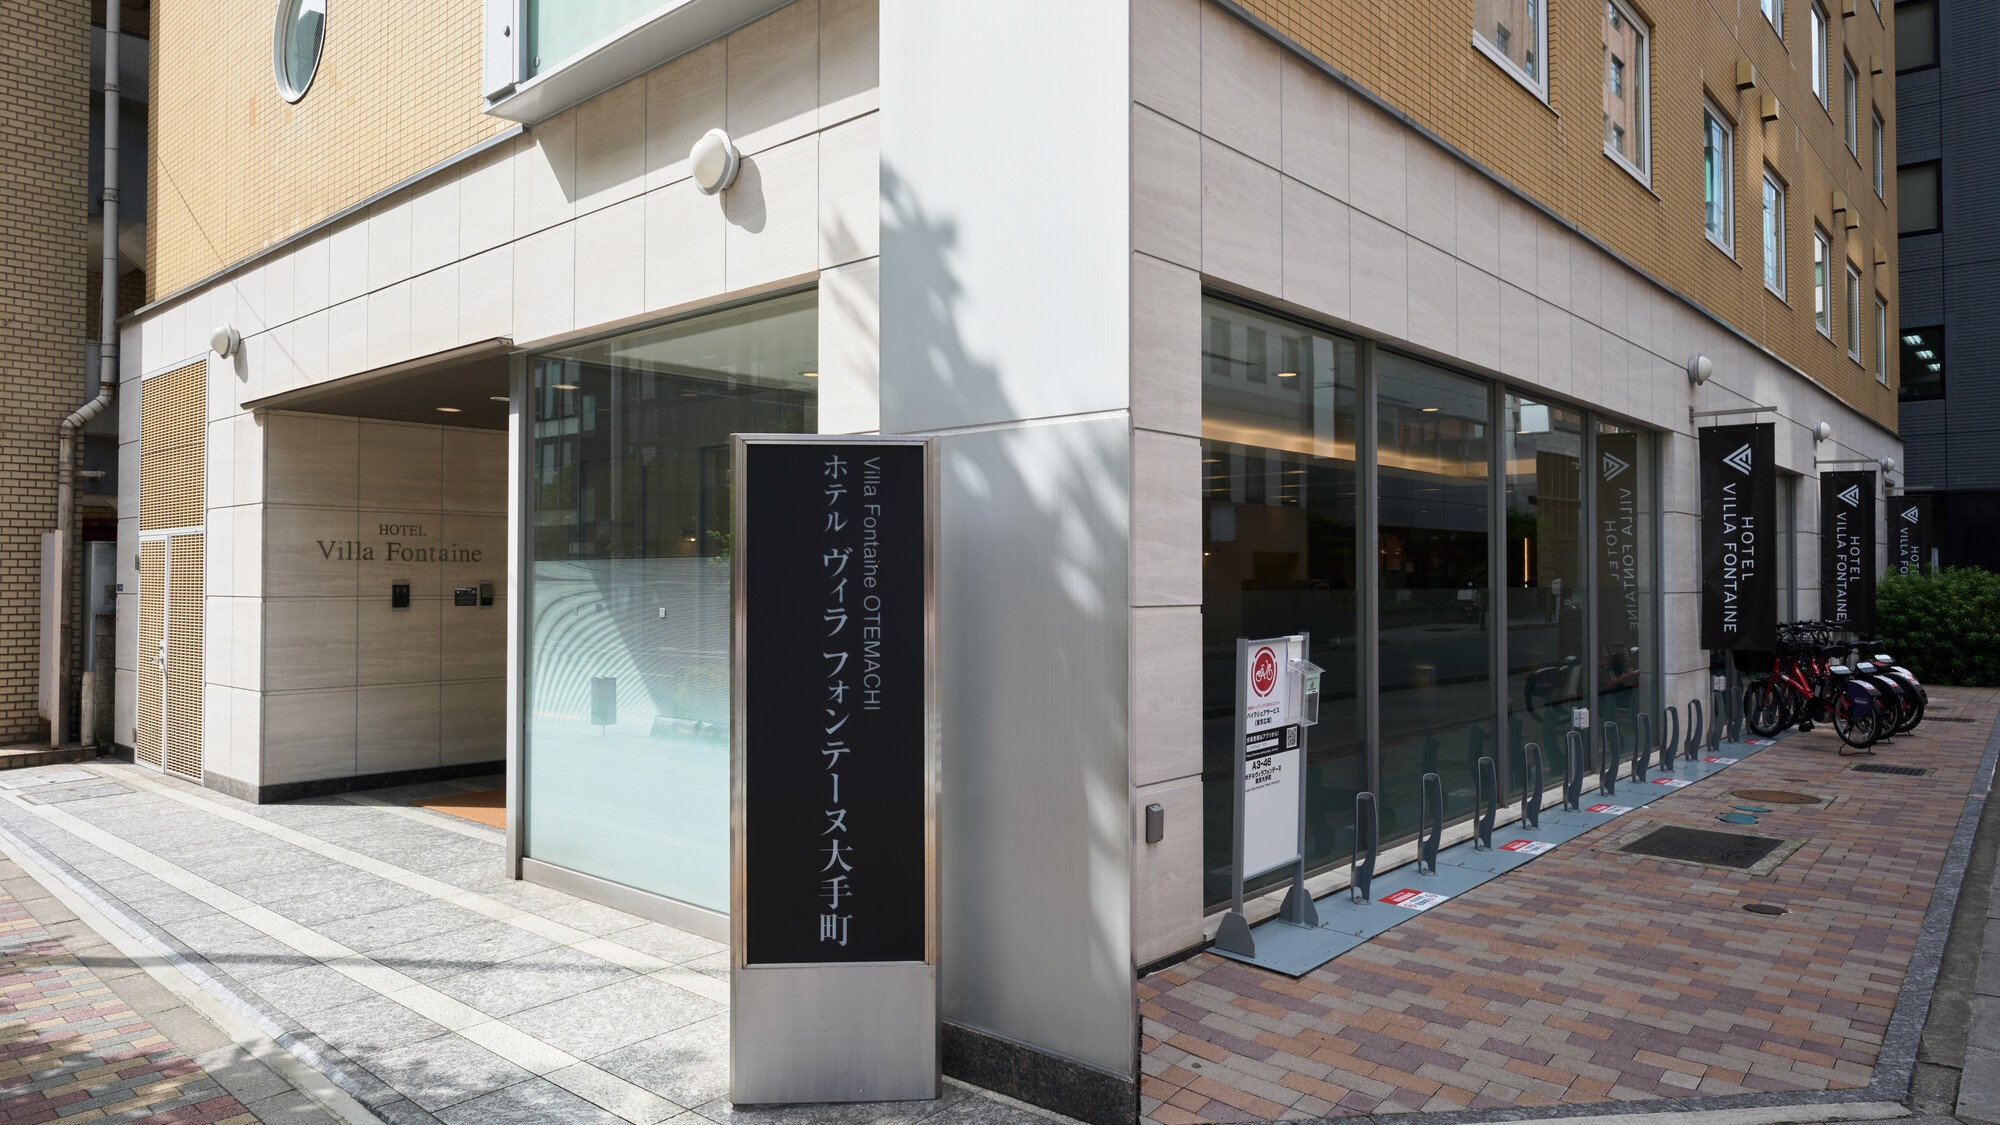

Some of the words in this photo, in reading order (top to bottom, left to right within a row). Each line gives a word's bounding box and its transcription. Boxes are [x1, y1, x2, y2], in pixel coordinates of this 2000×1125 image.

[824, 454, 848, 533] ホテル
[863, 456, 881, 497] Villa
[378, 524, 428, 537] HOTEL
[1722, 482, 1737, 534] VILLA
[1836, 511, 1847, 549] VILLA
[316, 540, 376, 561] Villa
[385, 541, 482, 563] Fontaine
[863, 504, 881, 588] Fontaine
[1741, 516, 1755, 581] HOTEL
[1849, 536, 1861, 582] HOTEL
[1900, 527, 1909, 556] VILLA
[1910, 546, 1920, 577] HOTE
[1723, 542, 1738, 633] FONTAINE
[1836, 554, 1847, 621] FONTAINE
[863, 595, 881, 710] OTEMACHI
